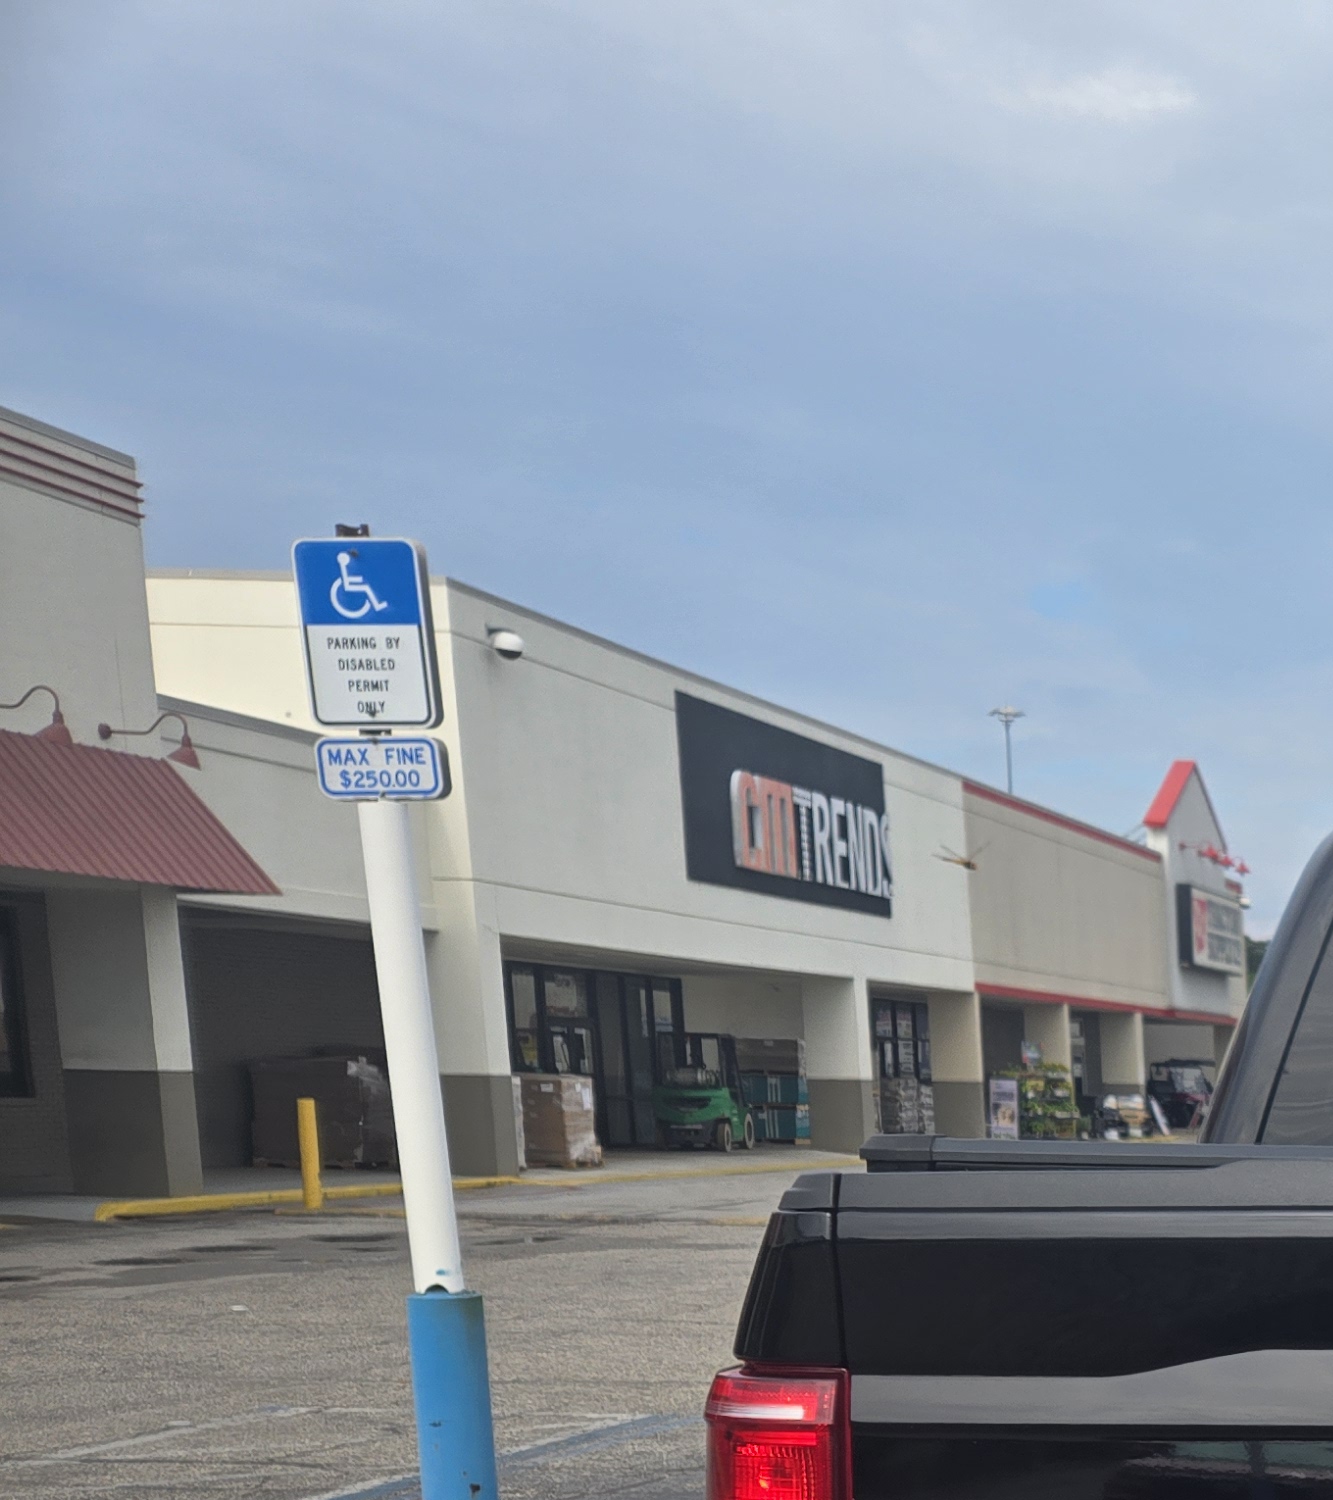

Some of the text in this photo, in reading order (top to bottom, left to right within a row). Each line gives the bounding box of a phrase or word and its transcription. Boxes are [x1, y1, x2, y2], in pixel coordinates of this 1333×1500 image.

[327, 637, 400, 650] PARKING BY
[338, 659, 395, 671] DISABLED
[348, 680, 389, 692] PERMIT
[357, 701, 386, 714] ONLY
[327, 747, 427, 766] MAX FINE
[339, 770, 420, 789] $250.00
